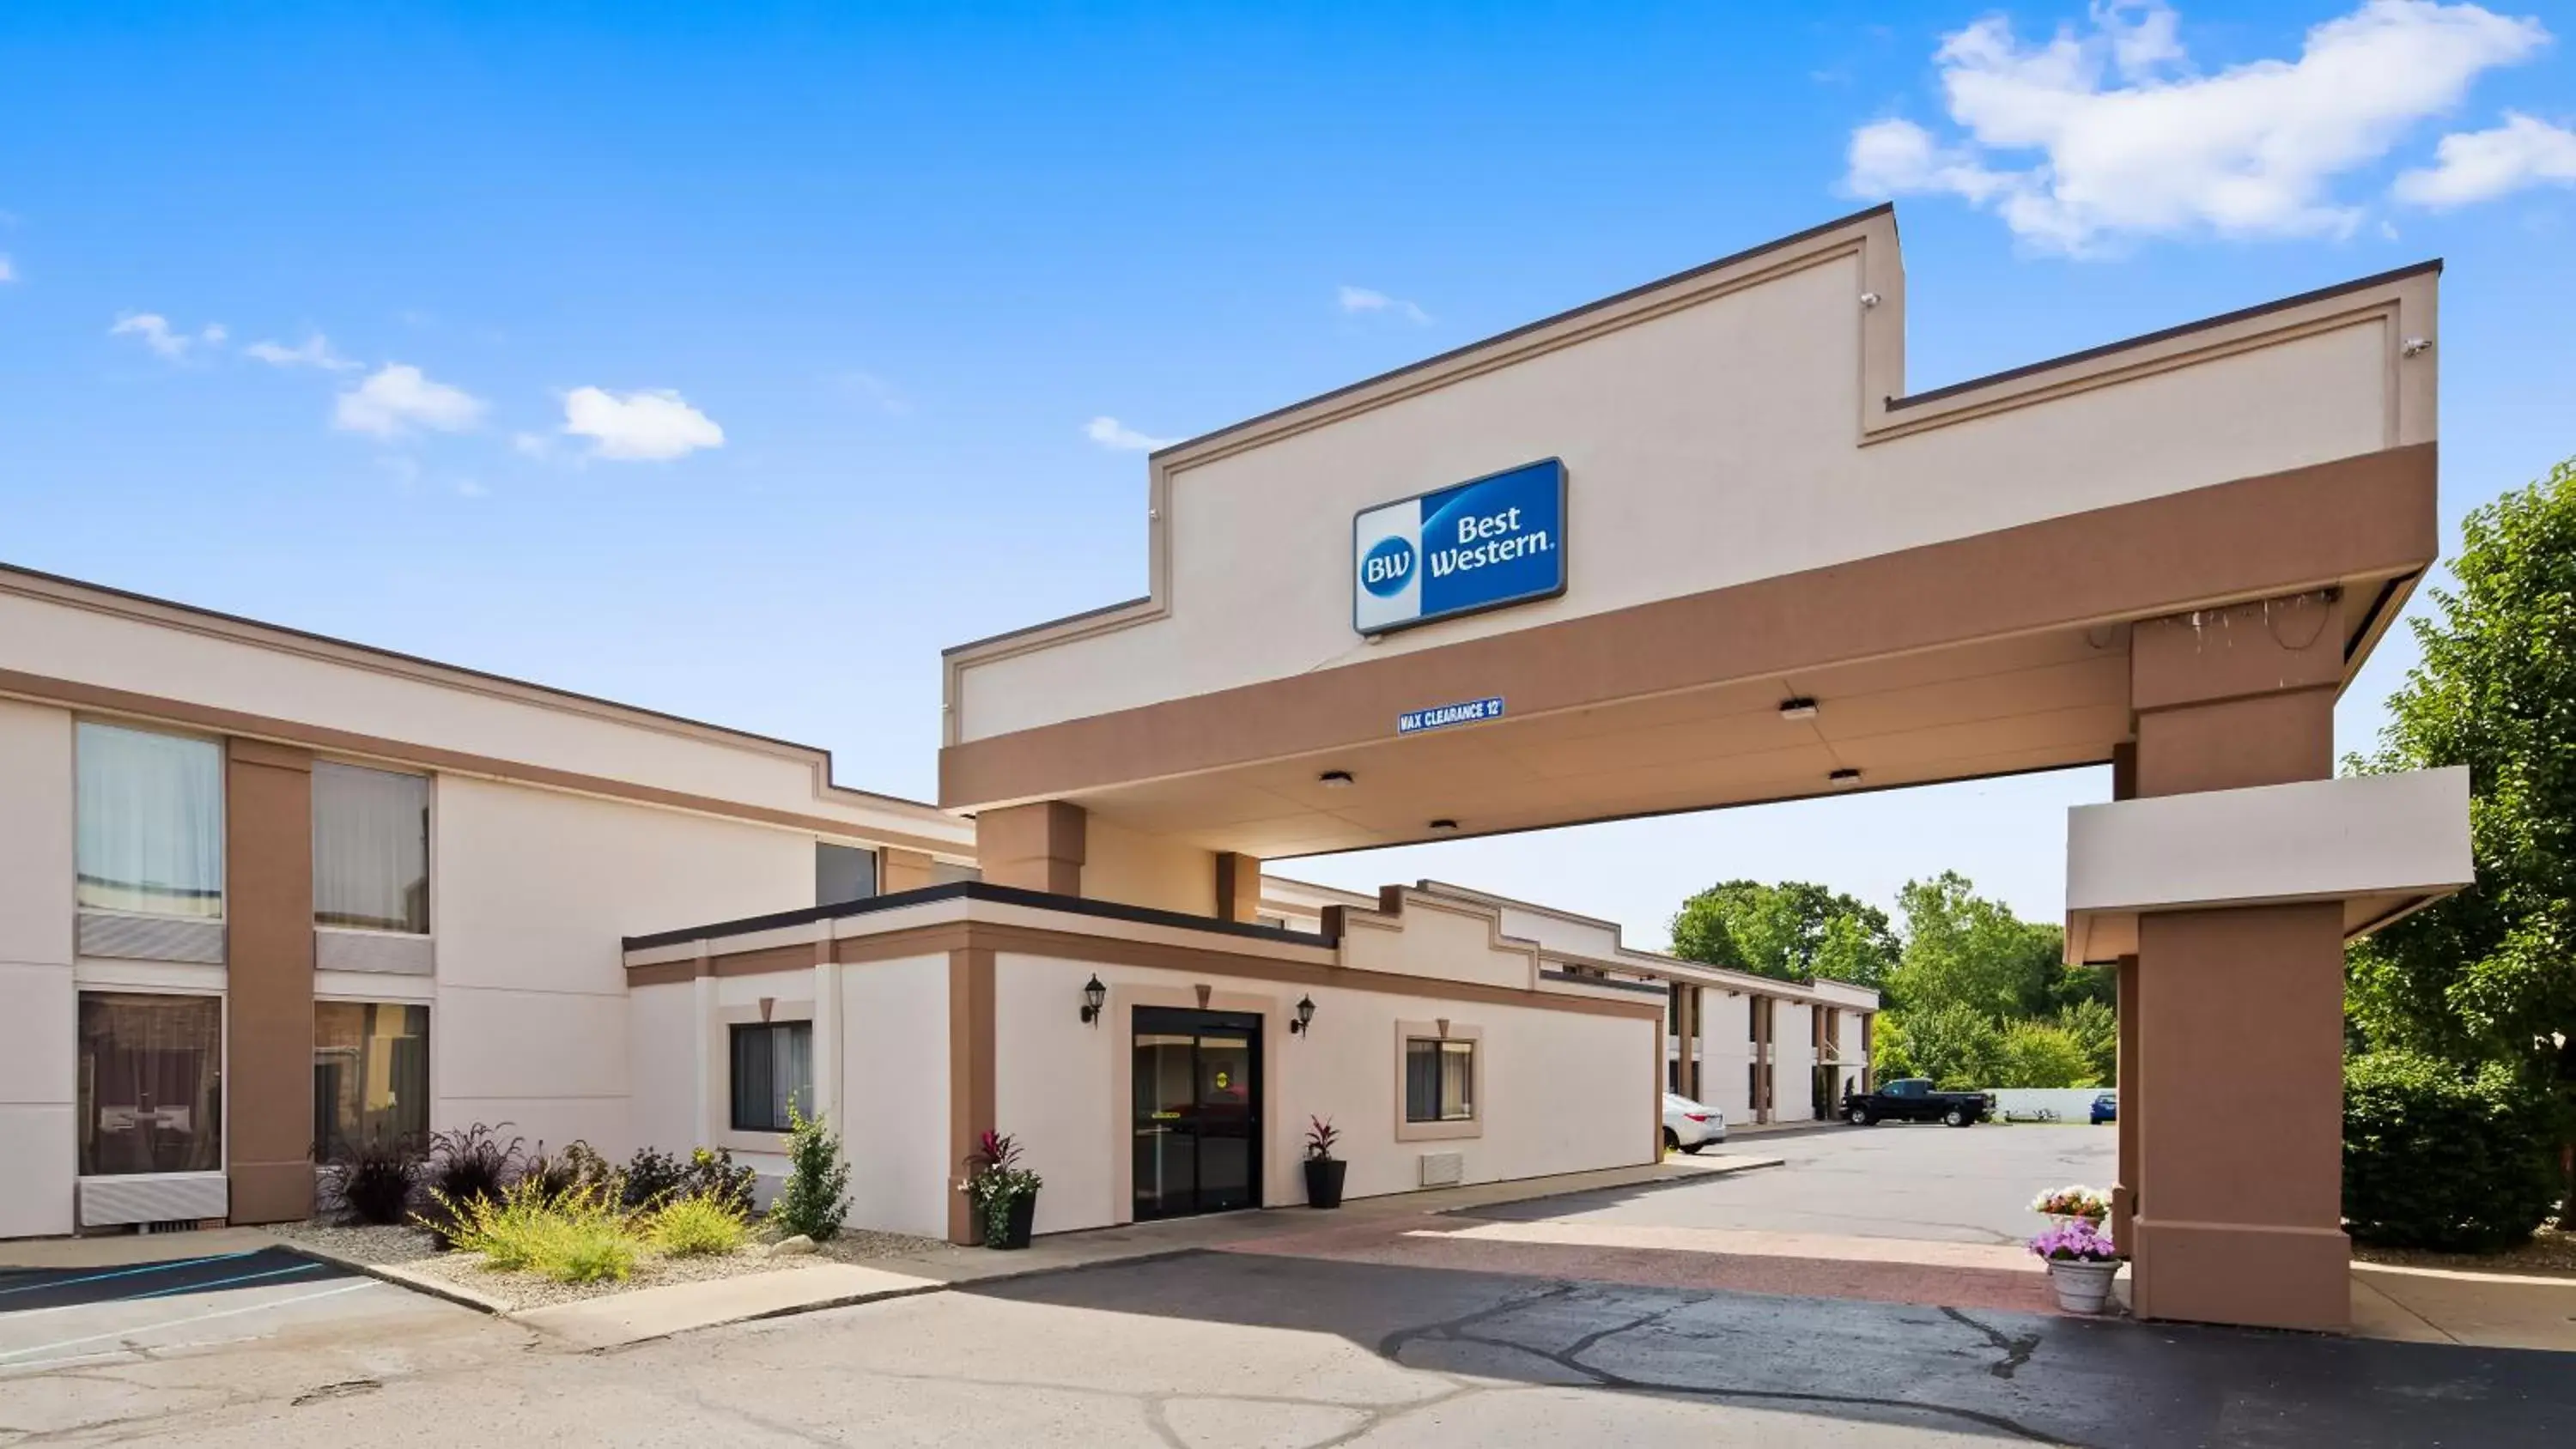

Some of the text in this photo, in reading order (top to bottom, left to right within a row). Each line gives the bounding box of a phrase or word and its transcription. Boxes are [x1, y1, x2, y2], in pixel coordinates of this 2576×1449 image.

[1459, 506, 1521, 543] Best
[1367, 551, 1410, 582] BW
[1400, 713, 1422, 731] MAX
[1425, 703, 1484, 726] CLEARANCE
